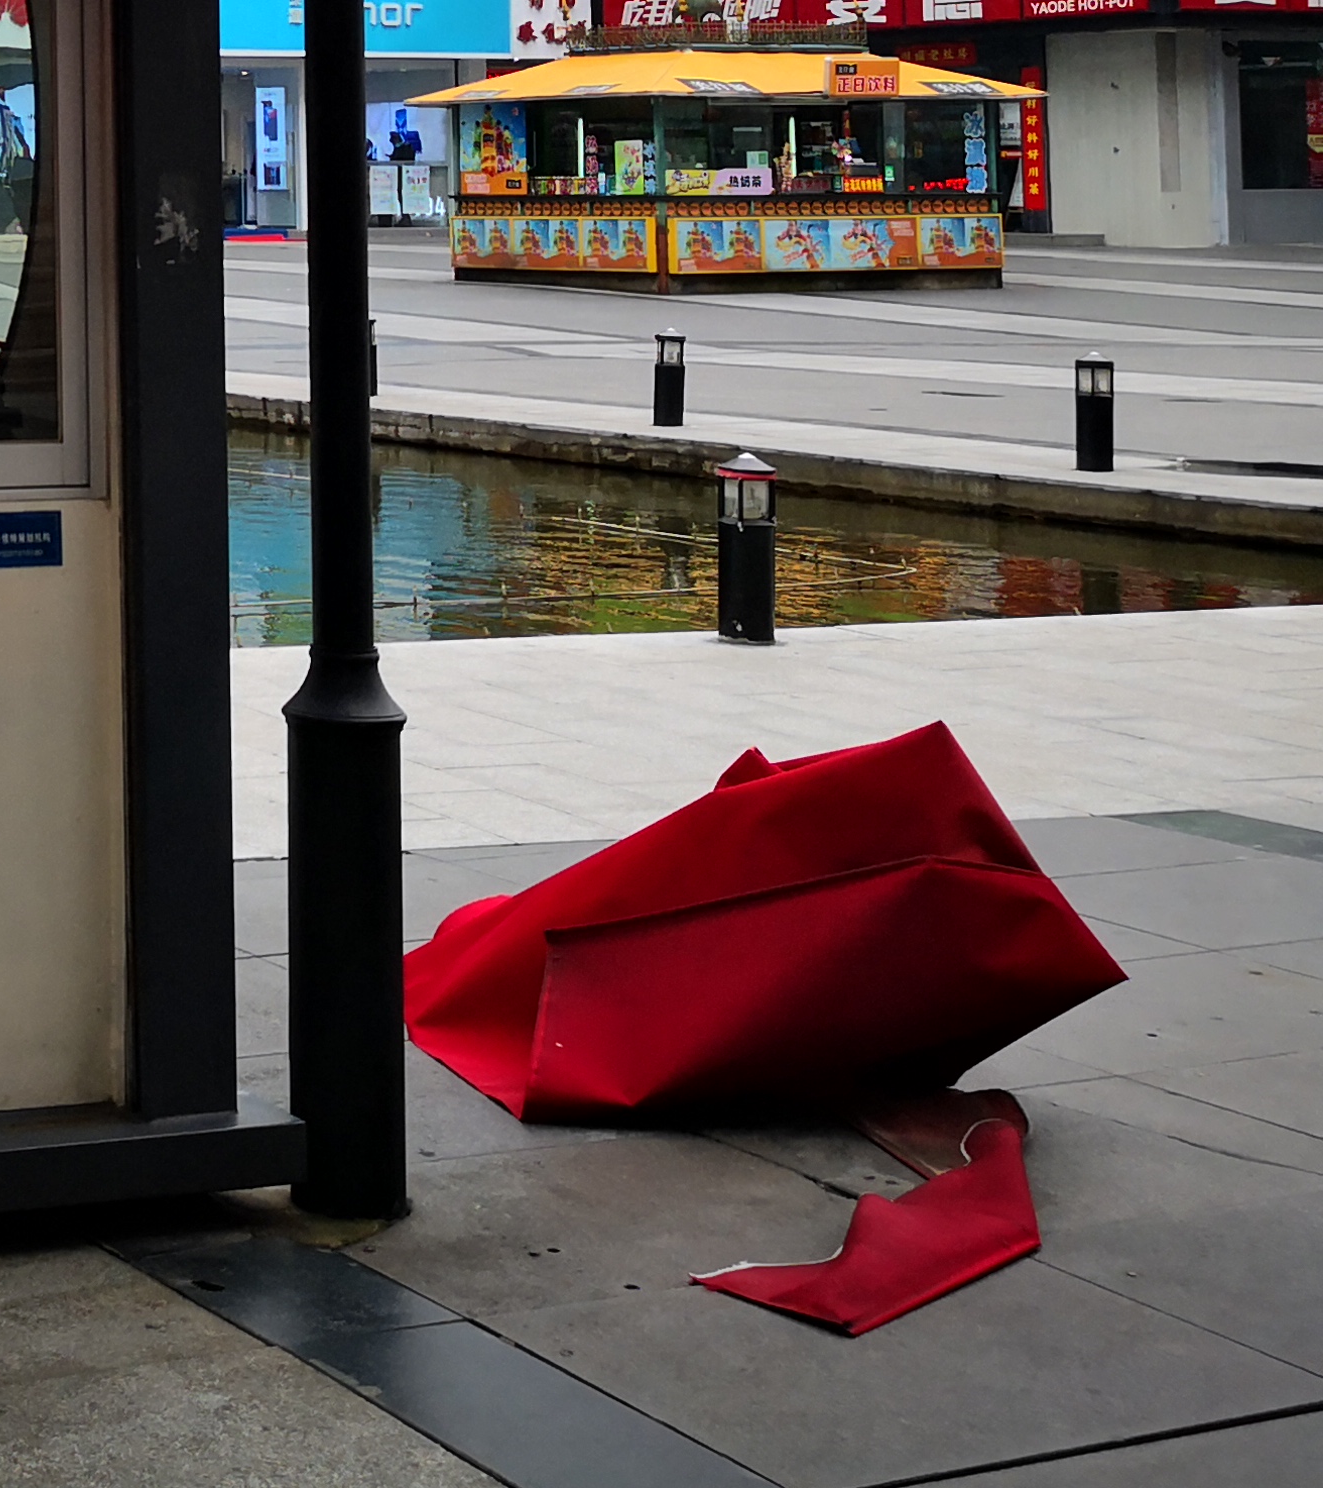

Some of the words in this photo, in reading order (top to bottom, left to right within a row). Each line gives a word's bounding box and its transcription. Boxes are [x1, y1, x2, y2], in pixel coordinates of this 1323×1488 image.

[1030, 0, 1076, 16] YAODE
[728, 174, 763, 189] 热奶茶
